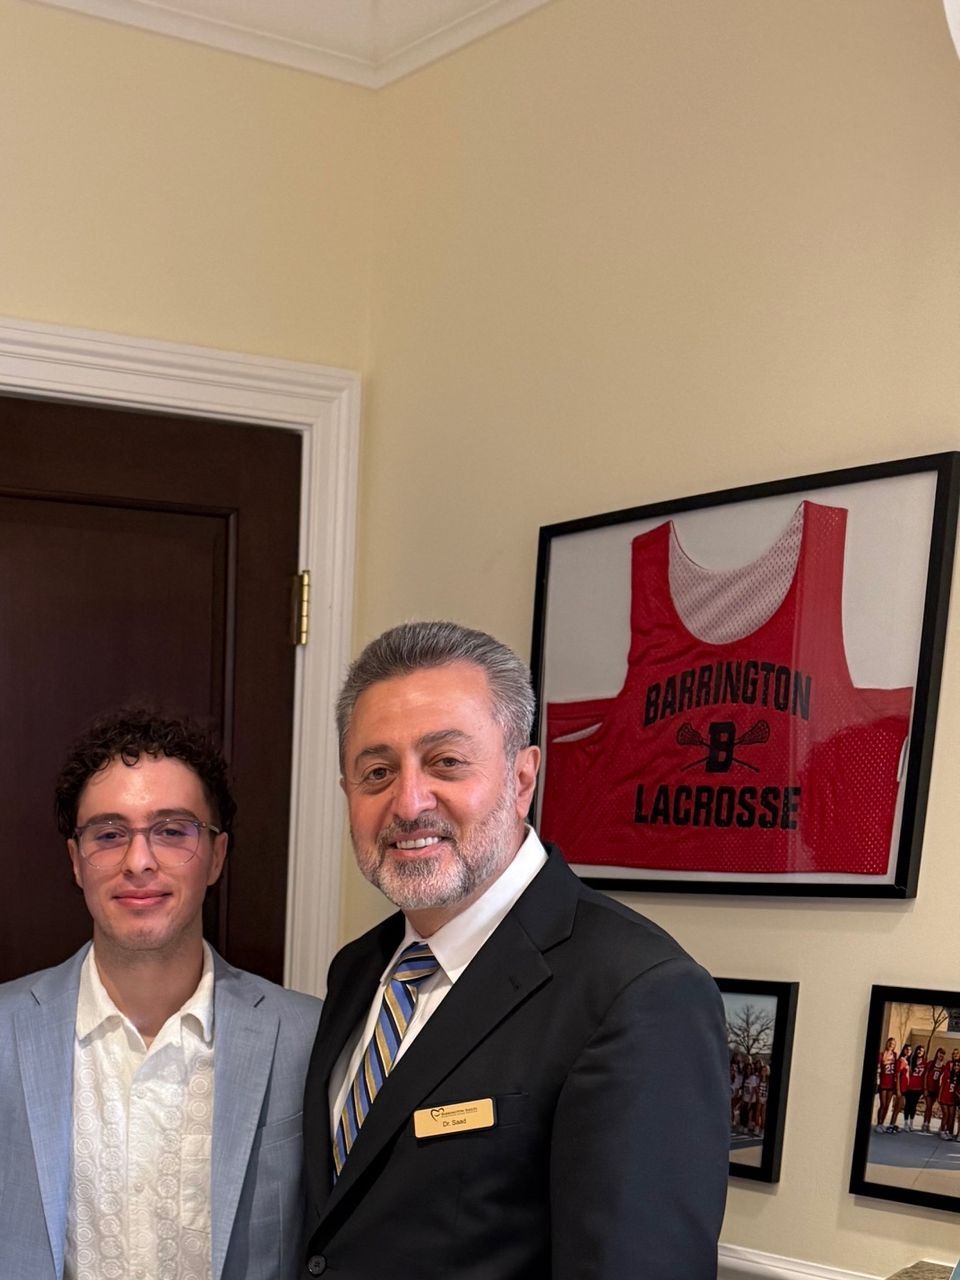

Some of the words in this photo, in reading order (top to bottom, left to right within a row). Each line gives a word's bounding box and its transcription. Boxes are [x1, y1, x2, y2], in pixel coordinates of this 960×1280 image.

[644, 660, 812, 727] BARRINGTON
[705, 721, 736, 773] B
[634, 784, 801, 830] LACROSSE
